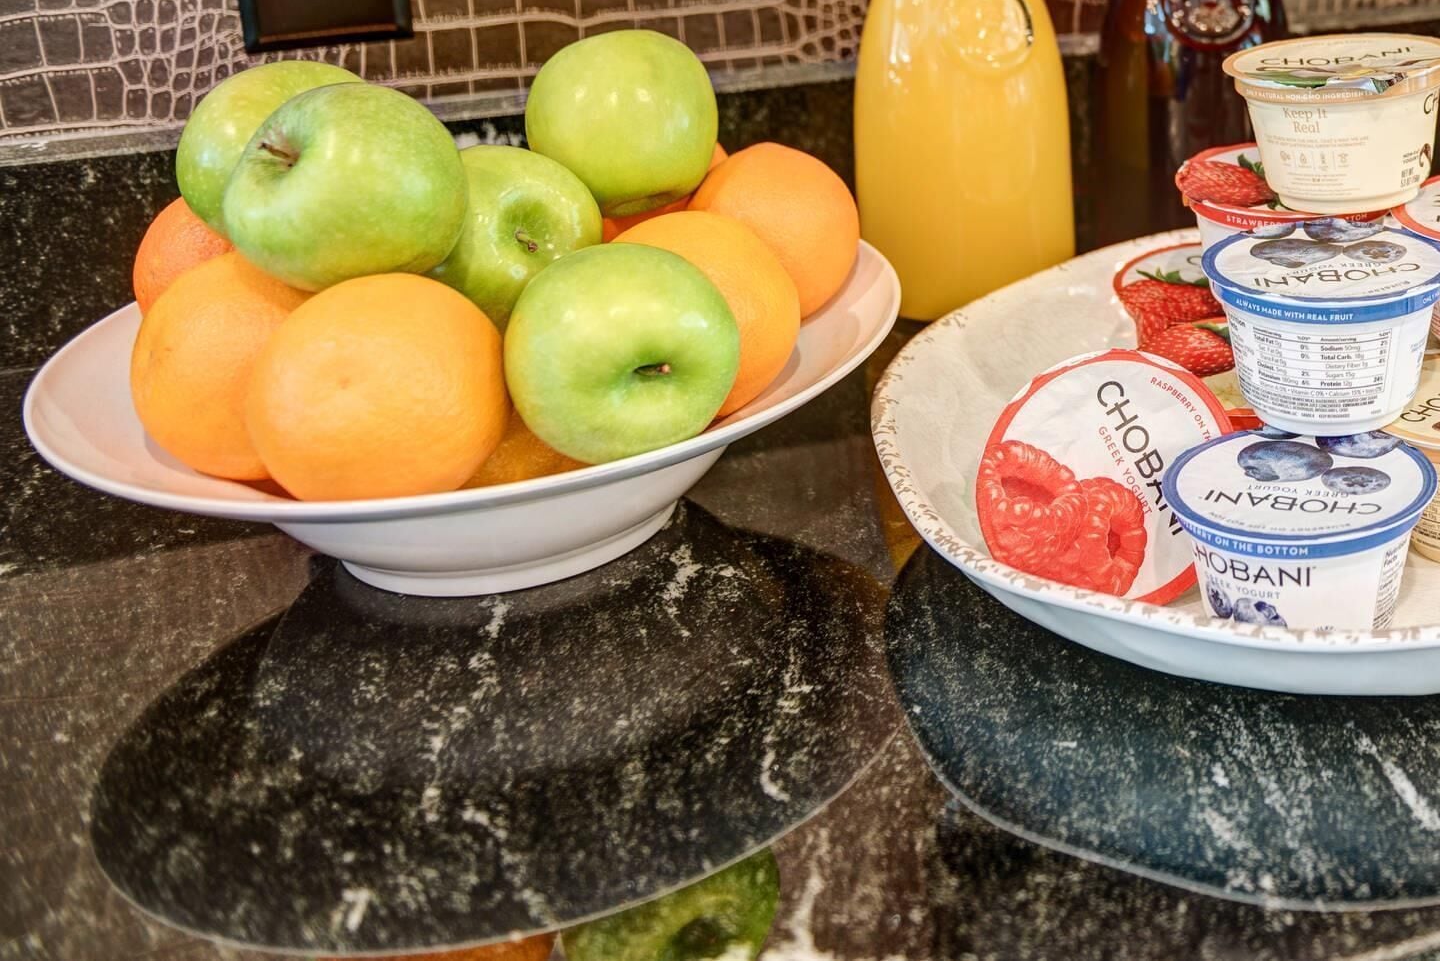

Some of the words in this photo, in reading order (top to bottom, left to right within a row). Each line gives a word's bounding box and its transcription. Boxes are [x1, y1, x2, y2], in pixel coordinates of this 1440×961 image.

[1286, 93, 1320, 101] NON-GMO
[1282, 107, 1312, 121] Keep
[1316, 109, 1328, 119] It
[1294, 121, 1320, 134] Real
[1254, 263, 1420, 287] CHOBANI
[1236, 298, 1260, 312] ALWAYS
[1262, 307, 1281, 316] MADE
[1284, 310, 1305, 319] WITH
[1307, 313, 1327, 321] REAL
[1330, 313, 1354, 321] FRUIT
[1150, 377, 1197, 413] RASPBERRY
[1194, 414, 1206, 429] ON
[1202, 429, 1212, 441] TH
[1098, 426, 1125, 466] GREEK
[1122, 468, 1152, 515] YOGURT
[1247, 484, 1298, 493] YOGURT
[1306, 490, 1349, 498] GREEK
[1204, 490, 1382, 515] CHOBANI
[1215, 537, 1229, 547] ON
[1232, 541, 1253, 552] THE
[1257, 546, 1308, 556] BOTTOM
[1194, 544, 1310, 587] HOBANI
[1235, 586, 1280, 599] YOGURT
